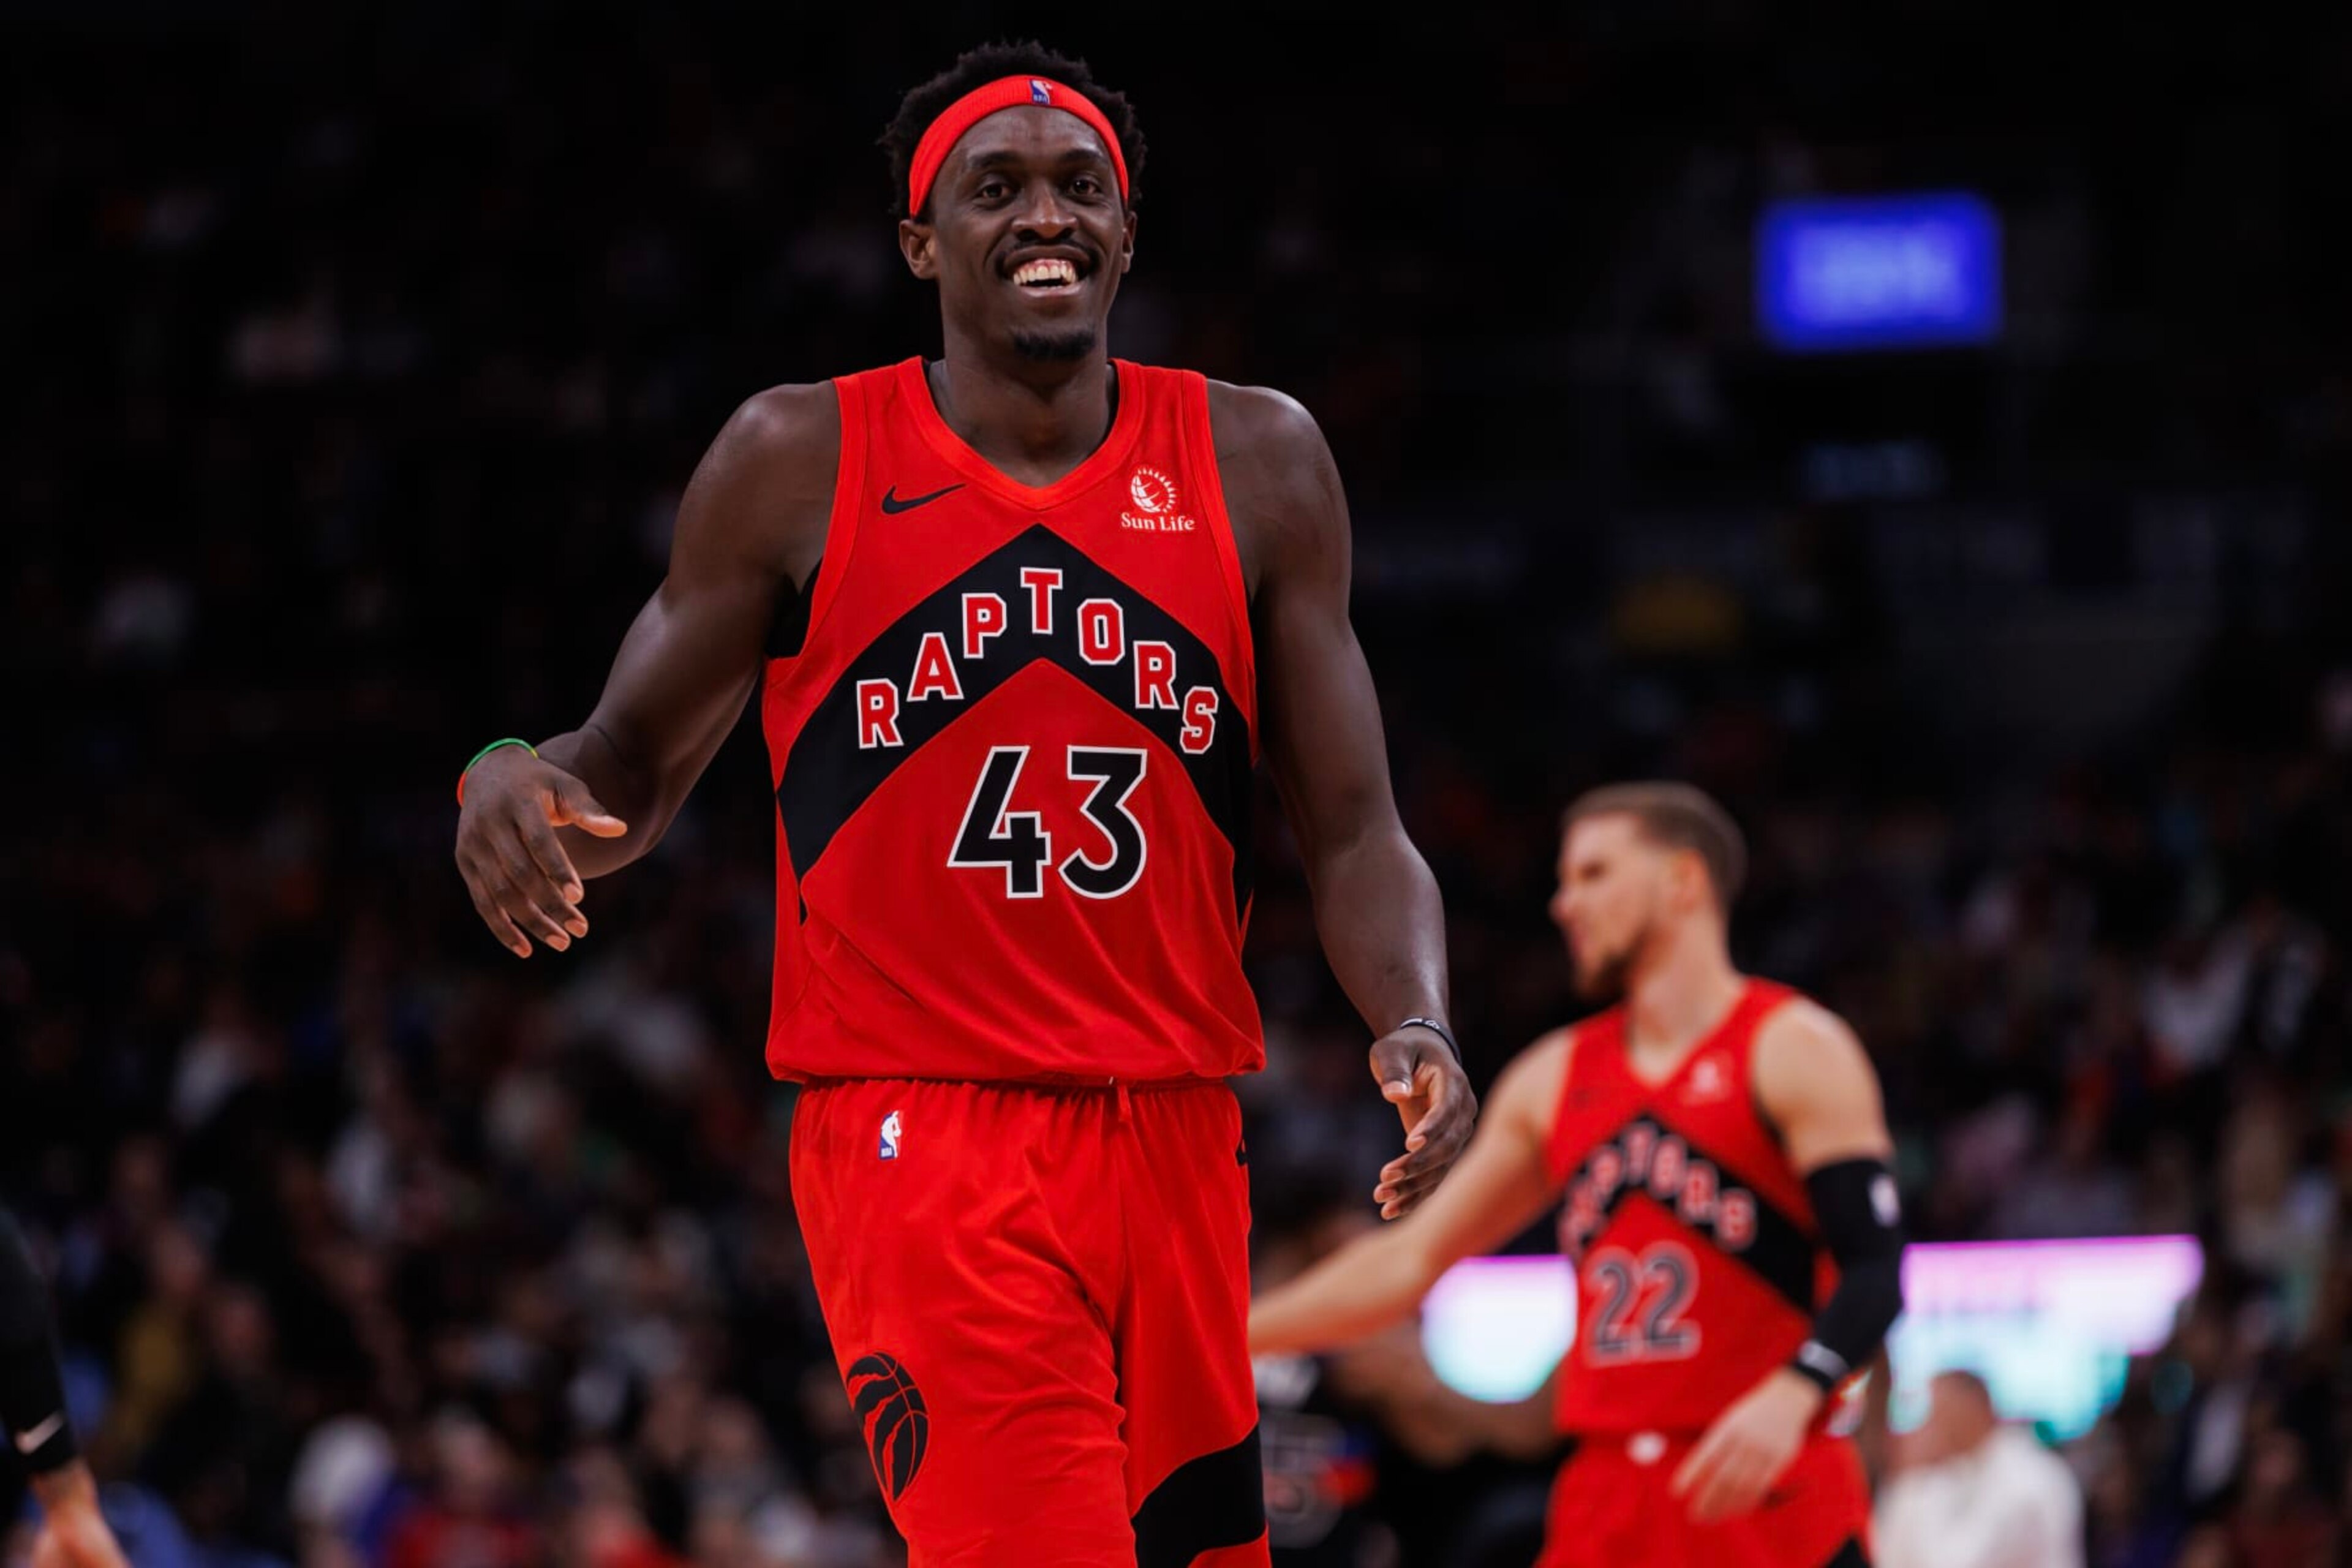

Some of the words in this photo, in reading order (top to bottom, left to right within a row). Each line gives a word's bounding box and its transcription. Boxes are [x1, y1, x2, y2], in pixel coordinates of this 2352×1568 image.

[1121, 512, 1156, 530] Sun
[1159, 516, 1195, 531] Life
[857, 567, 1219, 754] RAPTORS
[947, 745, 1148, 899] 43
[1586, 1243, 1701, 1365] 22
